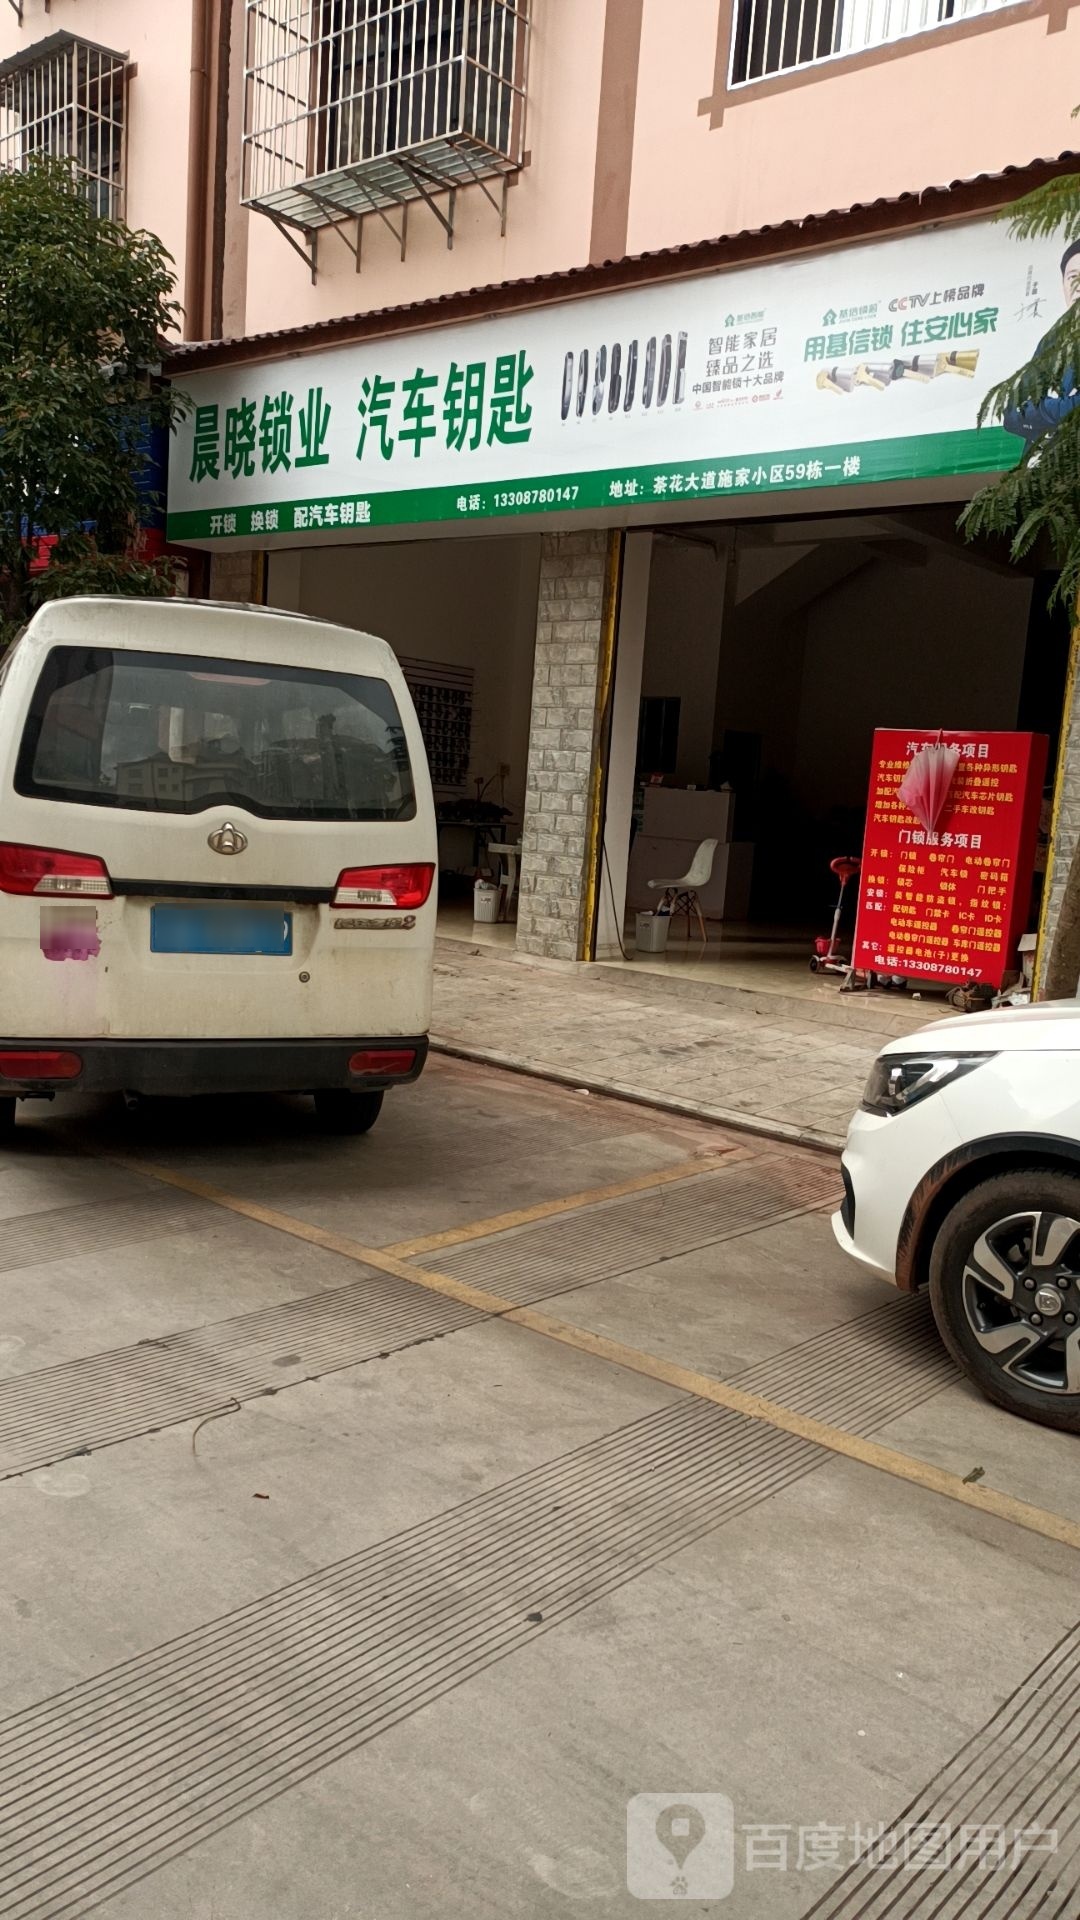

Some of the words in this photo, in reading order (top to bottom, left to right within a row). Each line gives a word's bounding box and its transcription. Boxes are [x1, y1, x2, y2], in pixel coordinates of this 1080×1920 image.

[708, 327, 777, 355] 智能家居
[803, 324, 894, 362] 用基信锁
[901, 307, 999, 347] 住安心家
[706, 351, 774, 377] 臻品之选
[692, 371, 784, 394] 中国智能锁十大品牌
[189, 387, 332, 483] 晨晓锁业
[355, 349, 535, 461] 汽车钥匙
[210, 513, 237, 535] 开锁
[250, 509, 279, 532] 换锁
[293, 501, 371, 528] 配汽车钥匙
[906, 741, 989, 758] 汽车务项目
[898, 829, 982, 849] 门锁服务项目
[898, 864, 925, 875] 保险柜
[928, 853, 955, 864] 卷帘门
[965, 856, 1010, 868] 电动卷帘门
[977, 885, 1007, 896] 门把手
[892, 904, 917, 915] 配钥匙
[925, 908, 950, 919] 门禁卡
[958, 911, 976, 922] IC卡
[984, 914, 1002, 924] ID卡
[890, 917, 938, 931] 电动车遥控器
[951, 924, 1003, 938] 卷帘门遥控器
[953, 938, 1001, 953] 车库门遥控器
[874, 955, 983, 978] 电话:13308780147
